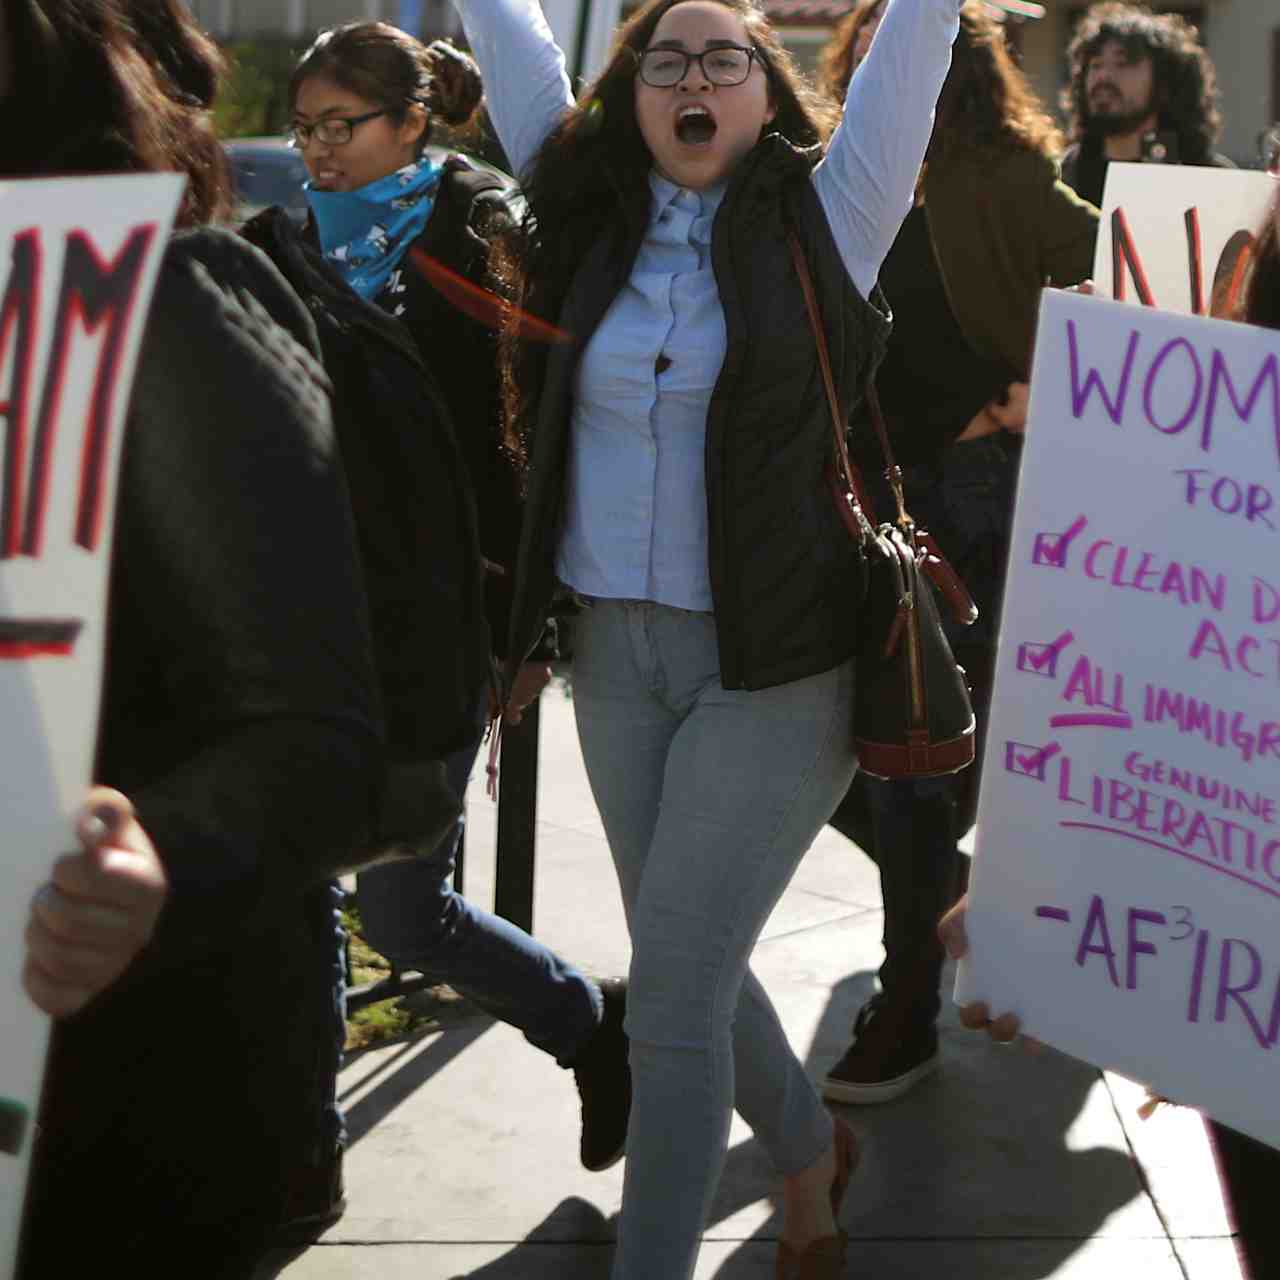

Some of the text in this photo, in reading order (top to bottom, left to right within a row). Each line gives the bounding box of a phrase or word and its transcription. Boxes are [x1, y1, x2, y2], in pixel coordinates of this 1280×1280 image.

[1172, 469, 1276, 530] FOR
[1084, 539, 1227, 612] CLEAN
[1063, 655, 1130, 715] ALL
[1125, 750, 1278, 824] GENUINE
